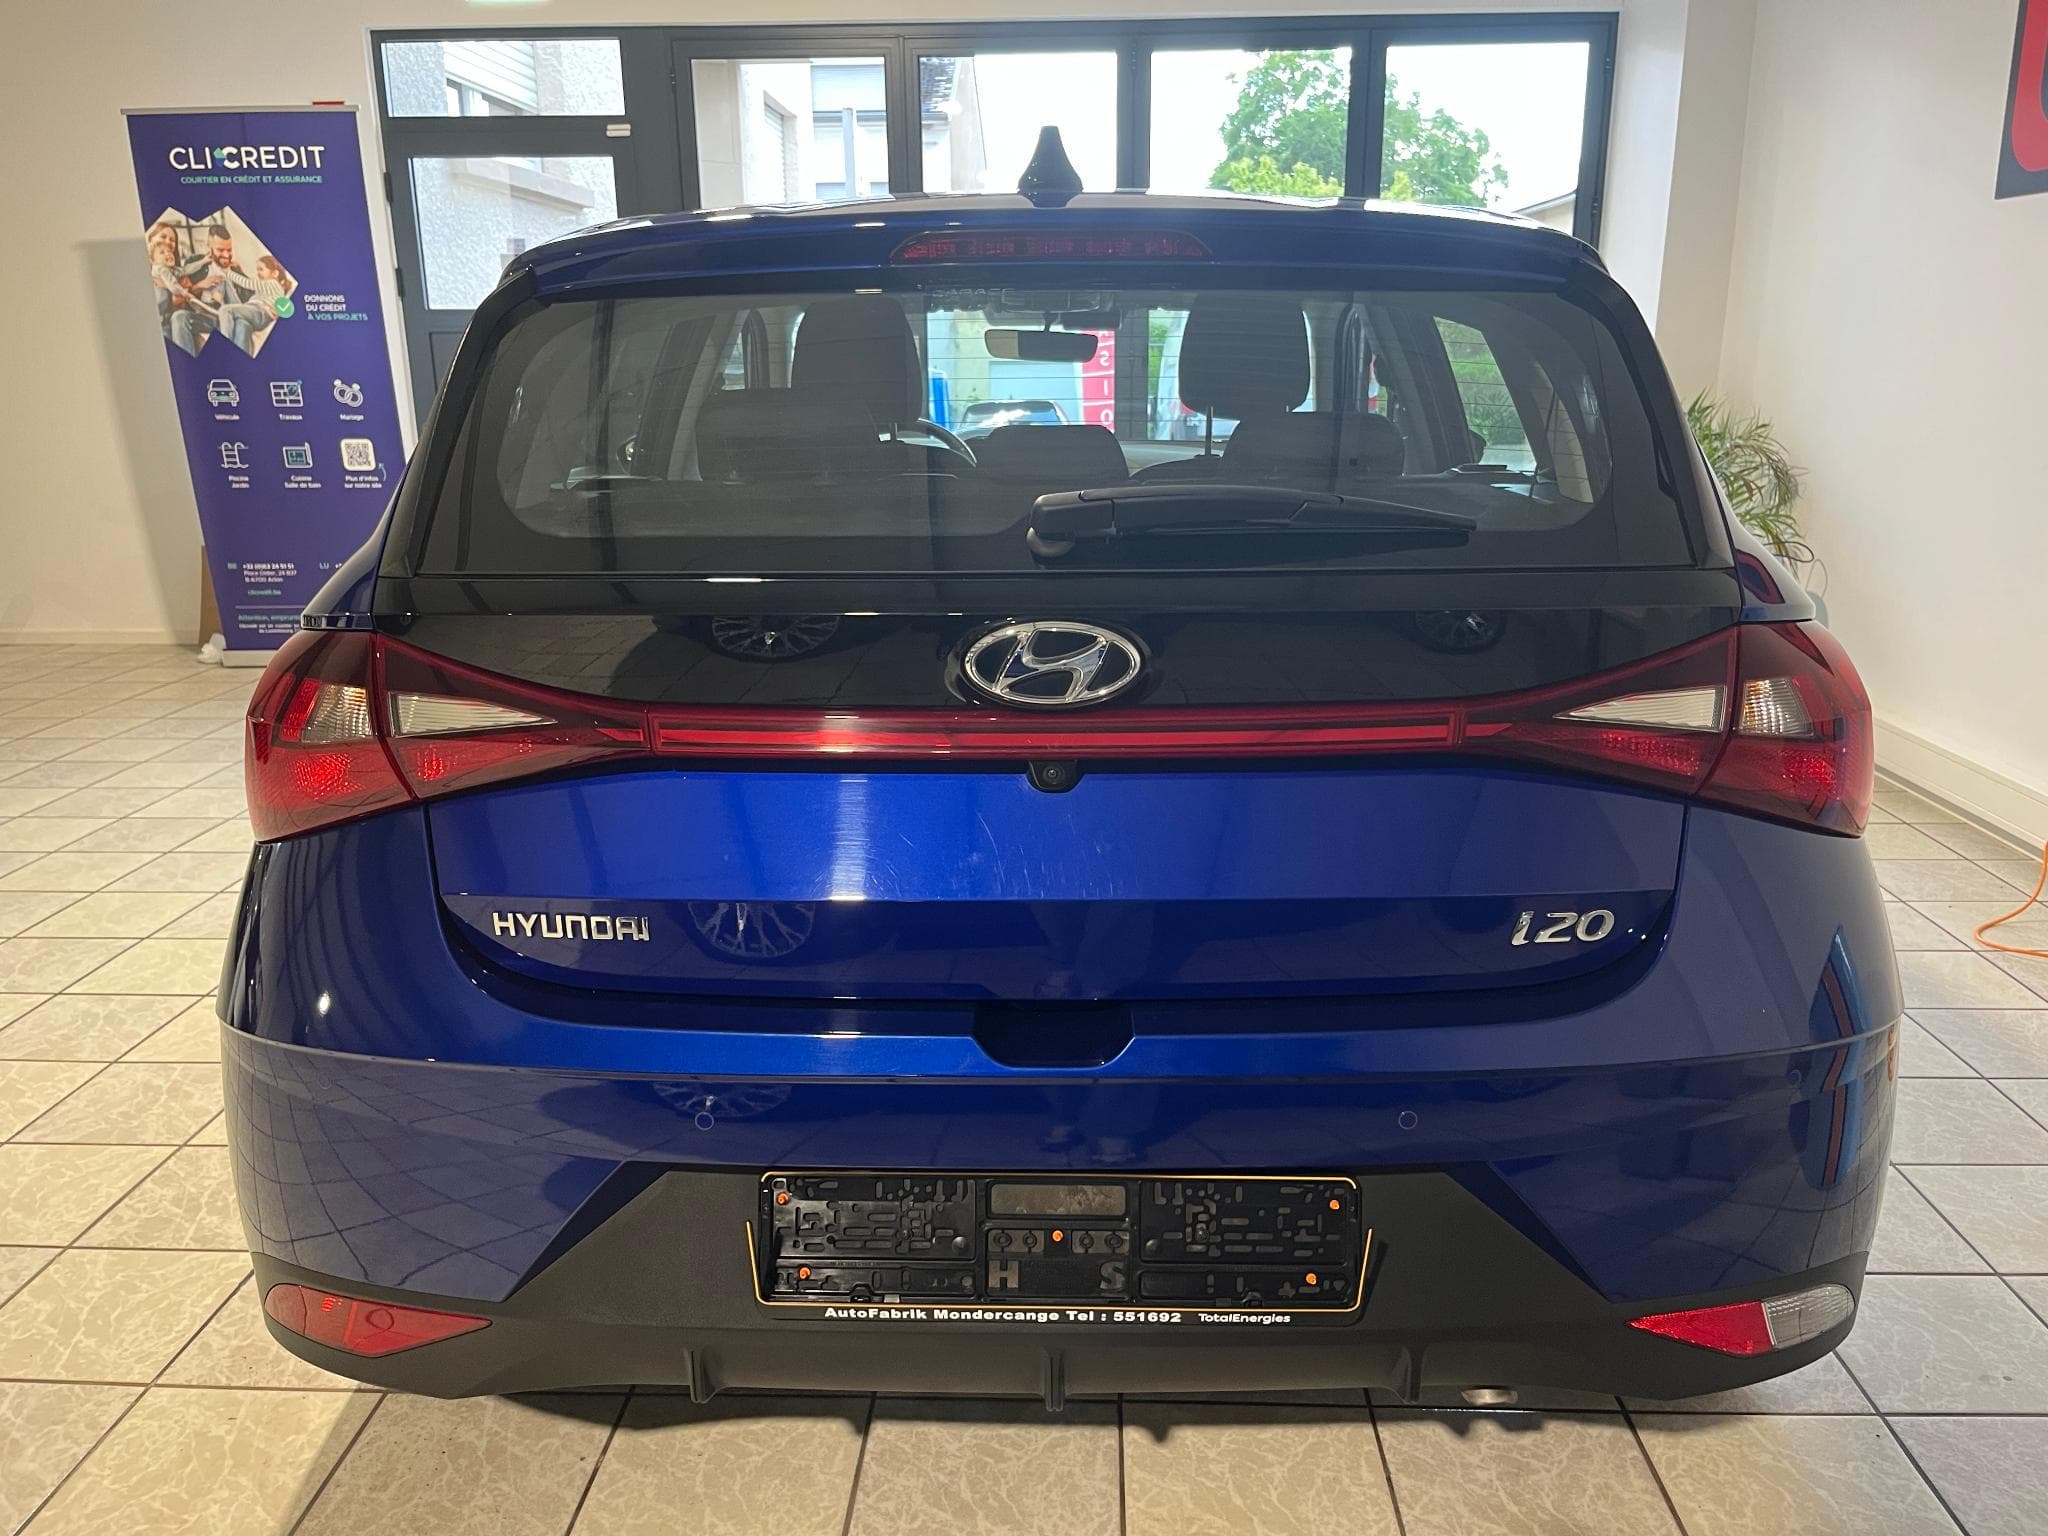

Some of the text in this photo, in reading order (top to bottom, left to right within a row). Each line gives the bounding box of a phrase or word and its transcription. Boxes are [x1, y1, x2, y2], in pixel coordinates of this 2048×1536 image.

[180, 174, 322, 184] COURTIER EN CRÉDIT ET ASSURANCE
[304, 294, 345, 303] DONNONS
[306, 303, 347, 312] DU CRÉDIT
[315, 313, 332, 321] VOS
[333, 313, 369, 321] PROJETS
[279, 413, 303, 421] Travaux
[340, 413, 364, 422] Mariage
[492, 912, 650, 941] HYUNDAI
[1511, 909, 1615, 946] i20
[824, 1307, 927, 1320] AutoFabrik
[933, 1309, 1060, 1322] Mondercange
[1066, 1310, 1094, 1321] Tel
[1113, 1311, 1181, 1322] 551692
[1198, 1313, 1291, 1325] TotalEnergies
